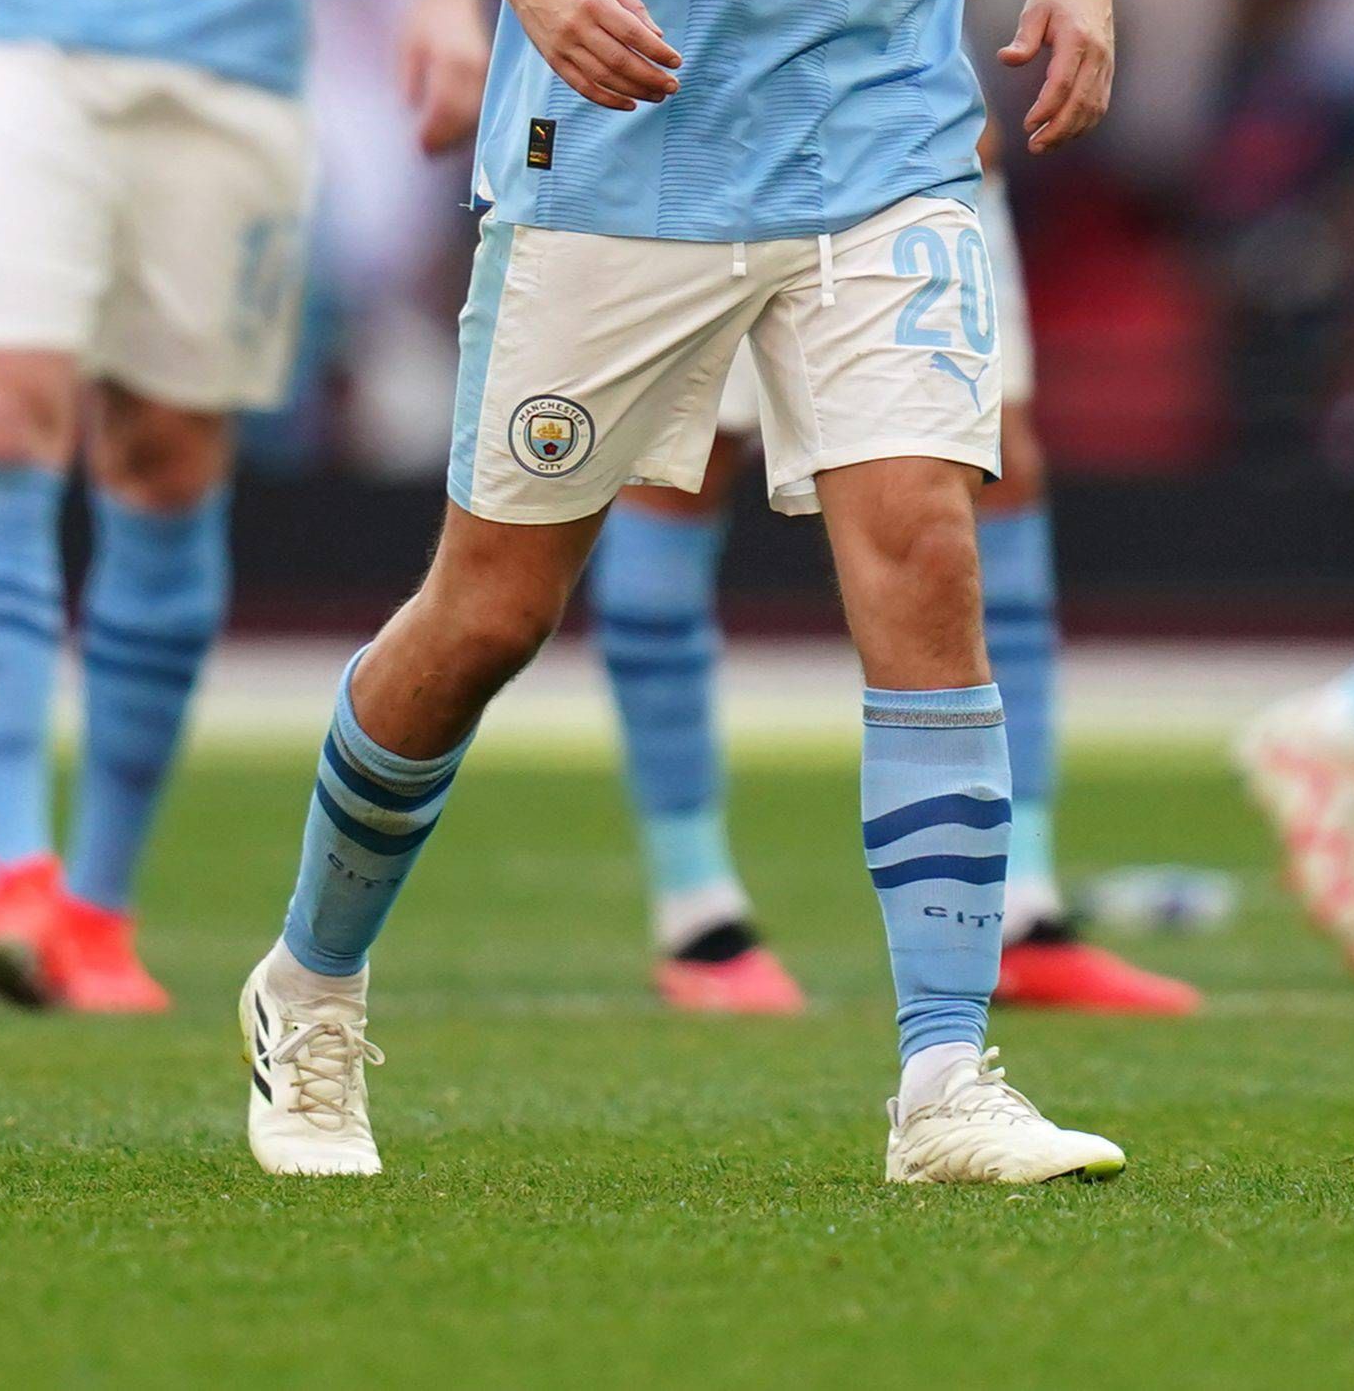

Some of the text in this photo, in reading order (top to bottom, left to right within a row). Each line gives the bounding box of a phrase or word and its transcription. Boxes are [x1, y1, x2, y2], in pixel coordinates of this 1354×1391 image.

[892, 224, 995, 356] 20
[518, 401, 586, 427] MANCHESTER
[537, 463, 564, 472] CITY
[923, 905, 1006, 928] CITY
